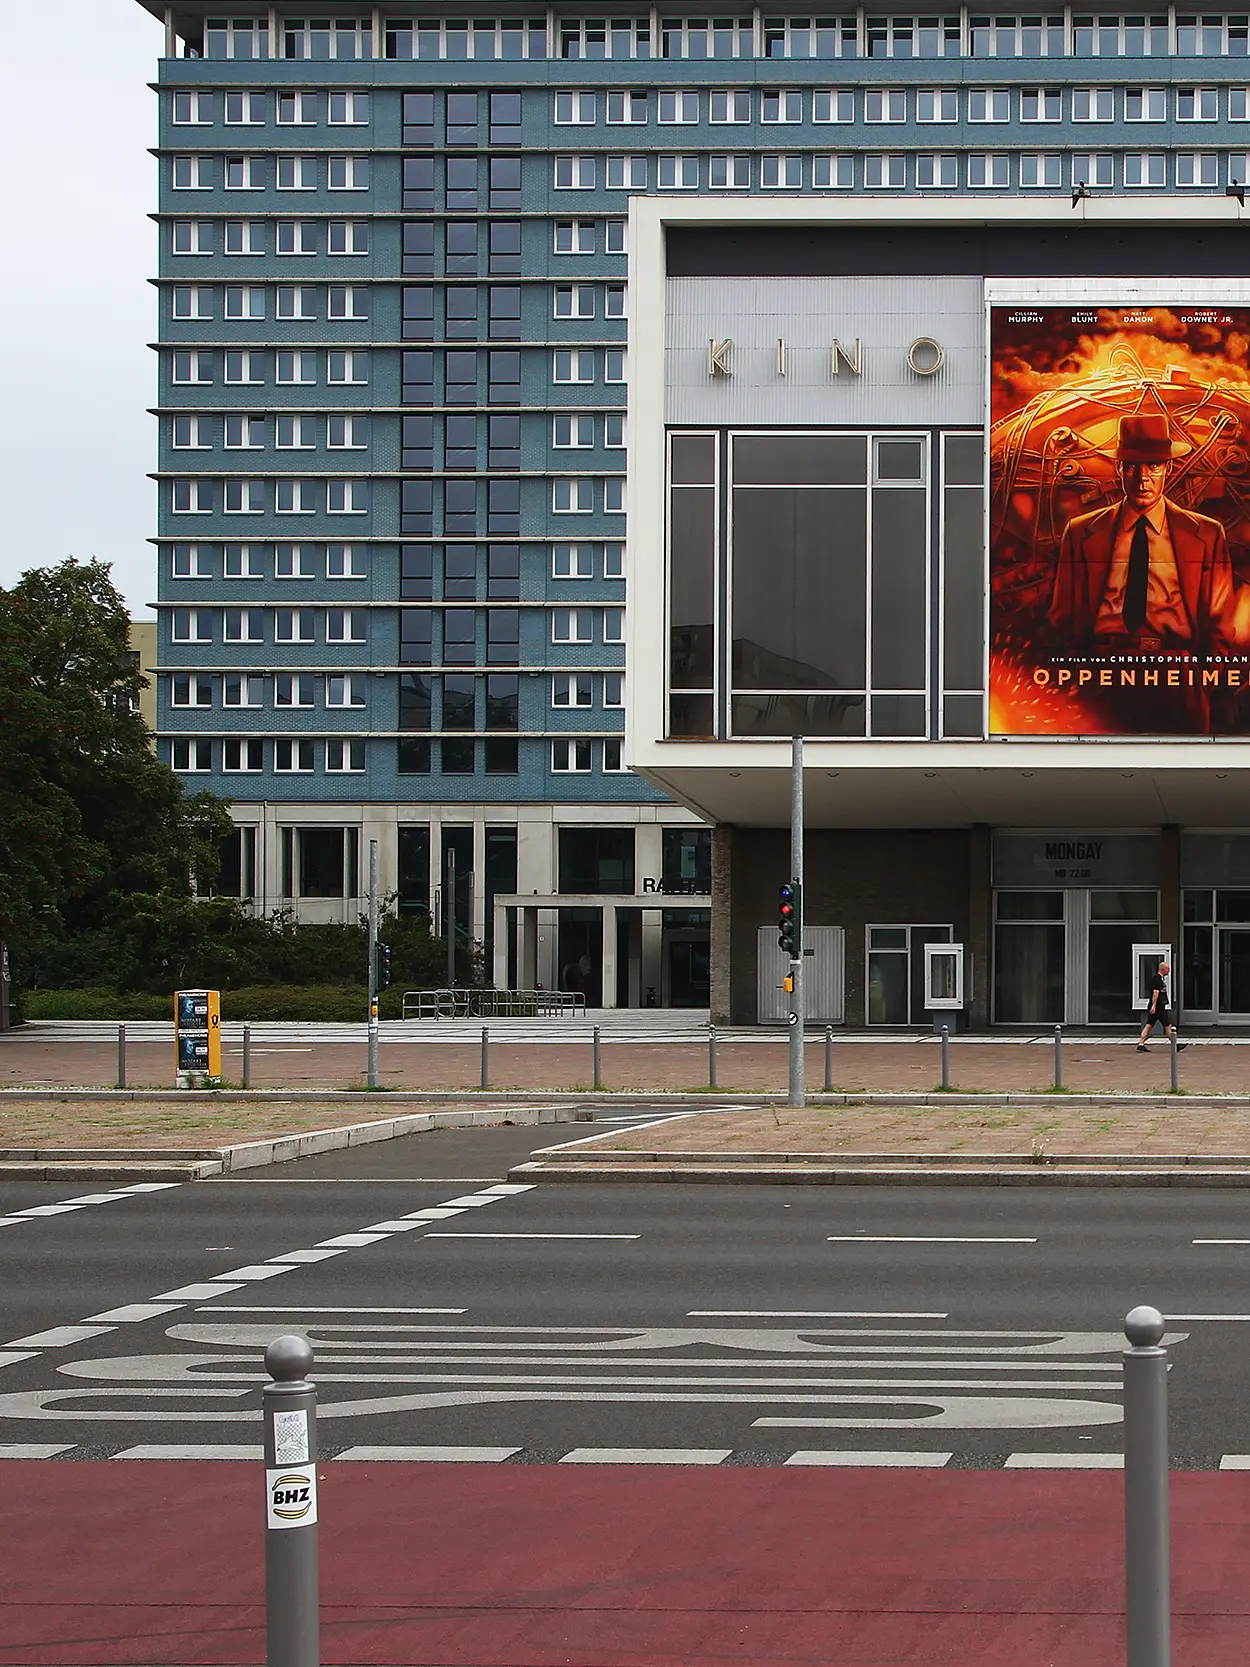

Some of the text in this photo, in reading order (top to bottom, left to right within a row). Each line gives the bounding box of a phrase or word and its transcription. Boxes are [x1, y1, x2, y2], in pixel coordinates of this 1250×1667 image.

[708, 335, 945, 377] KINO
[1110, 655, 1198, 663] CHRISTOPHER
[1206, 655, 1249, 663] NOLAN
[1045, 842, 1104, 860] MONGAY
[273, 1487, 310, 1505] BHZ
